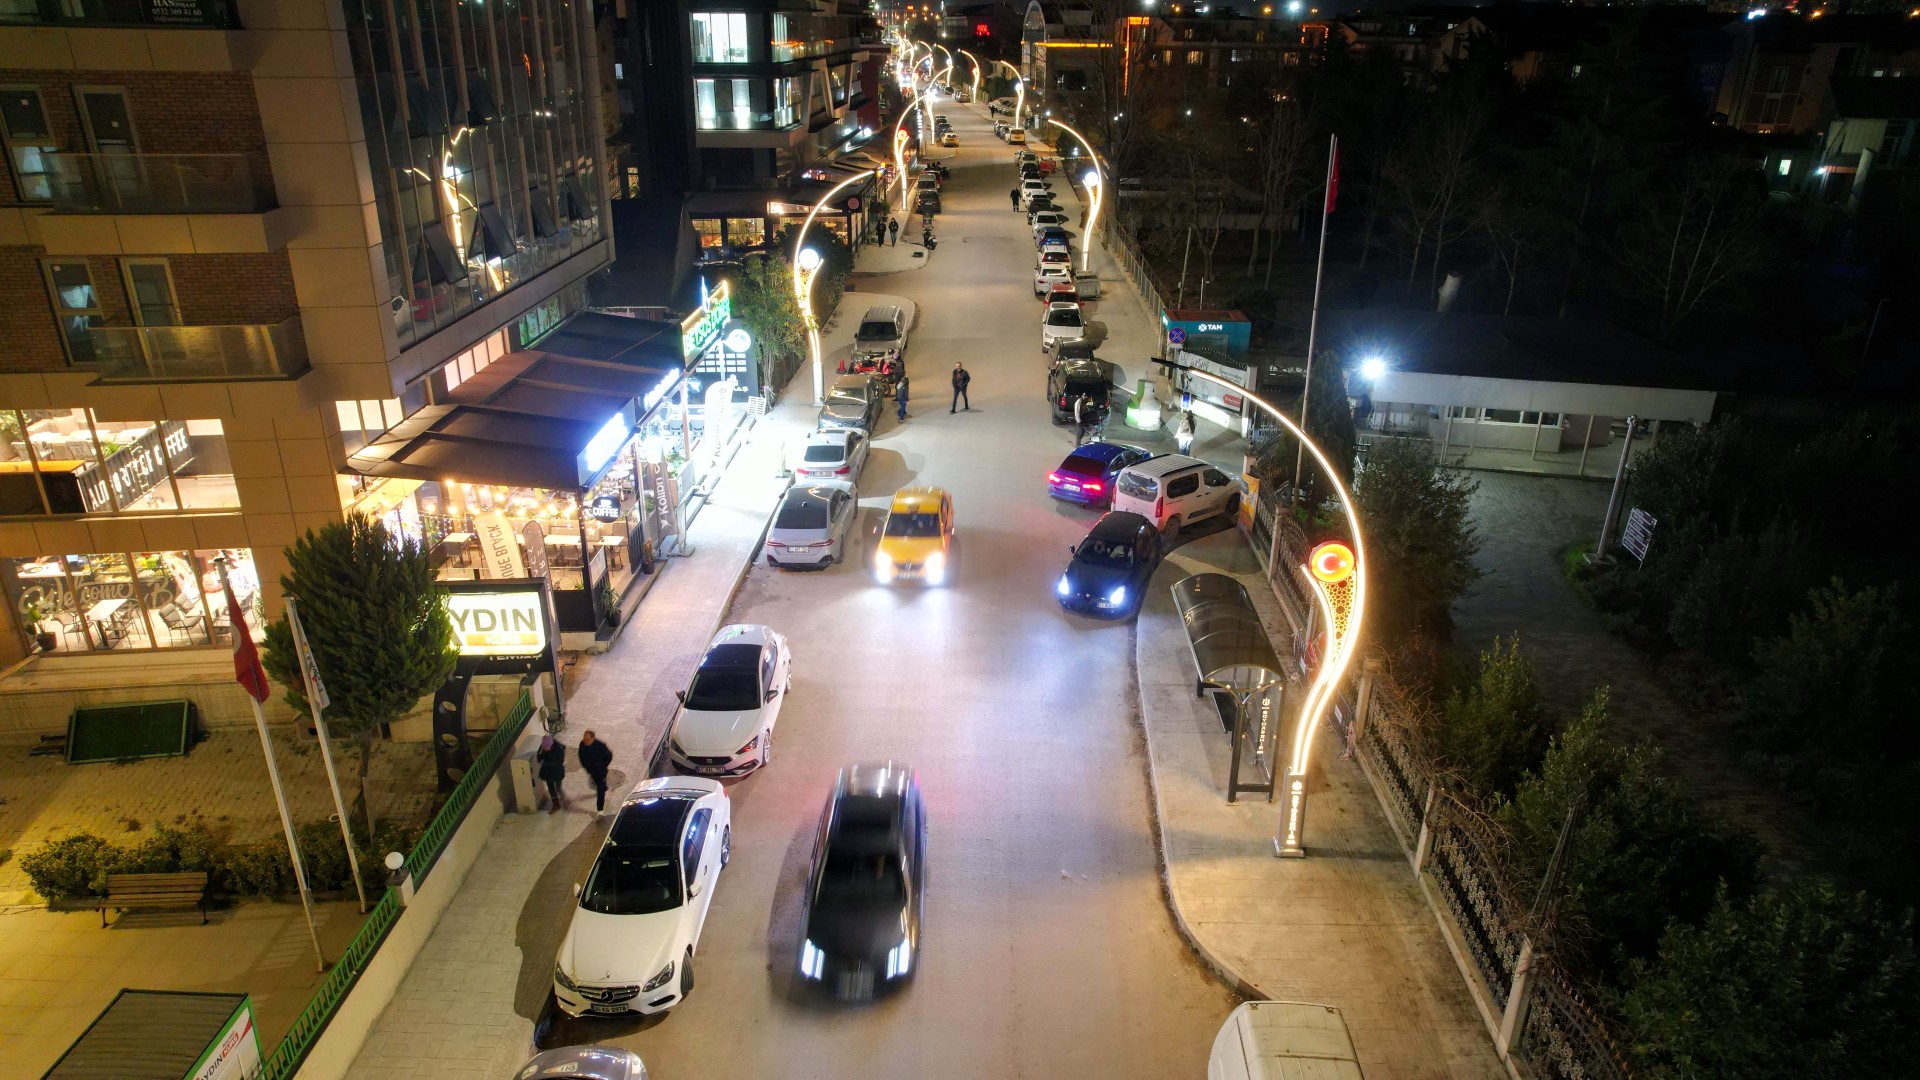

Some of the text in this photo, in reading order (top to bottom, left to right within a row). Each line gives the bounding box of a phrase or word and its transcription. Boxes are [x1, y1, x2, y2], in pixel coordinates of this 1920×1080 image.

[153, 427, 188, 466] CFFEE
[592, 507, 619, 518] COFFEE
[449, 607, 537, 635] YDIN
[201, 1054, 223, 1080] YDIN
